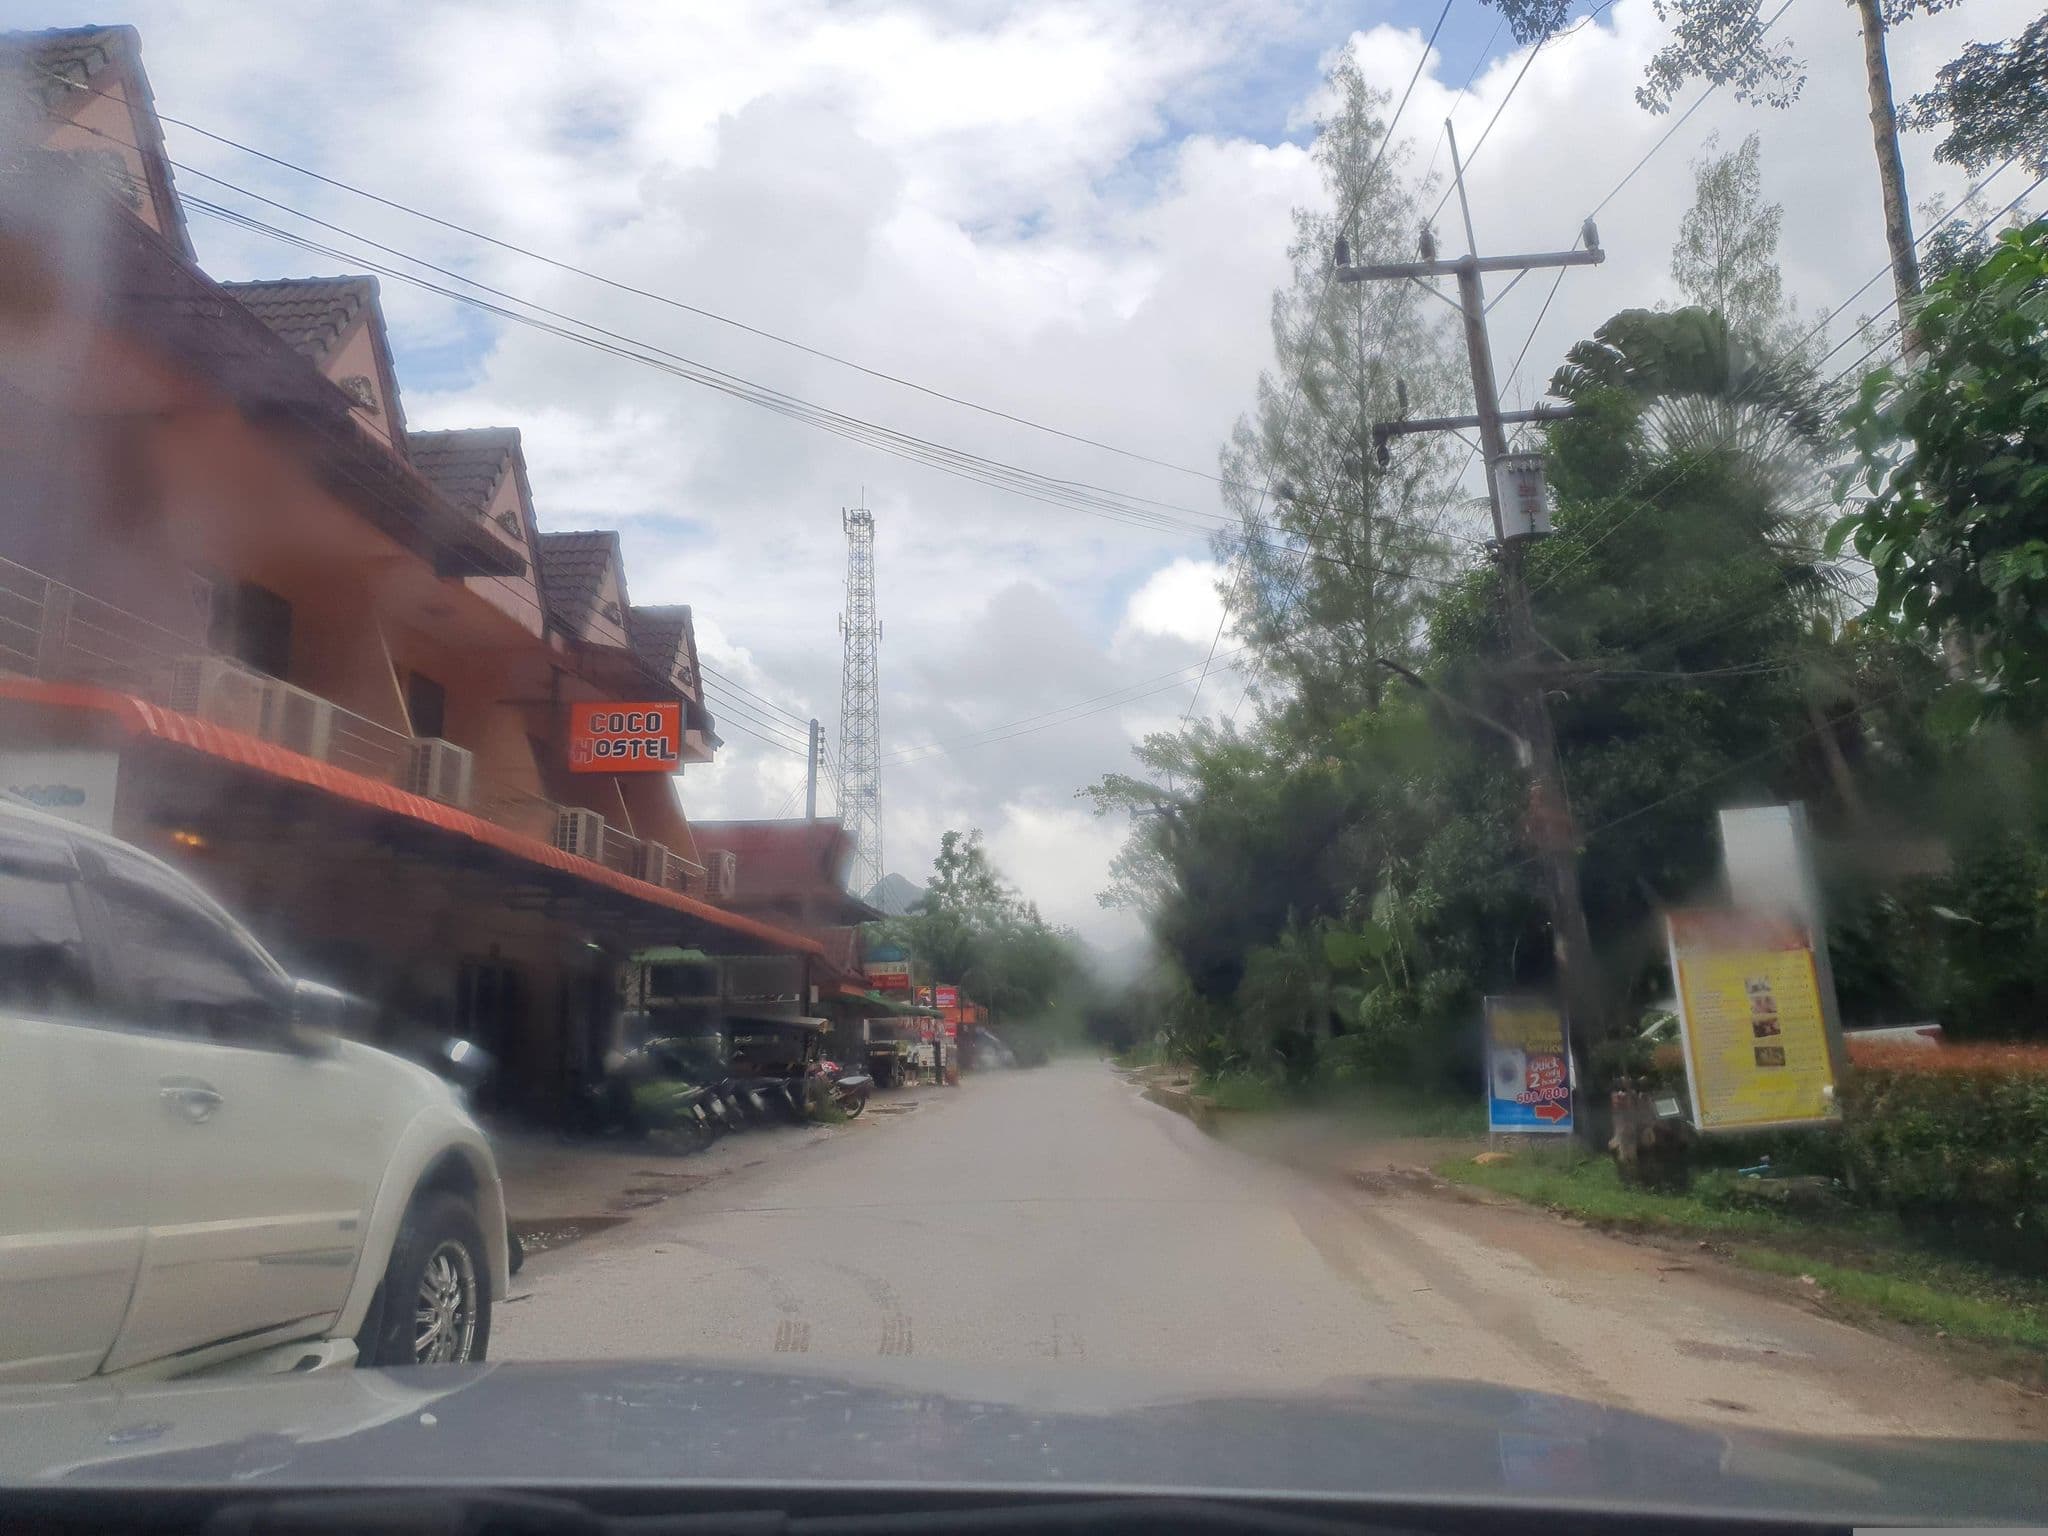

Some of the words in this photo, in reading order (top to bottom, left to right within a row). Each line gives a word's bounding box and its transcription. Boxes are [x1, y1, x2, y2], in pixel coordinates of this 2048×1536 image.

[589, 711, 662, 734] COCO
[571, 736, 677, 763] HOSTEL
[1530, 1073, 1541, 1088] 2
